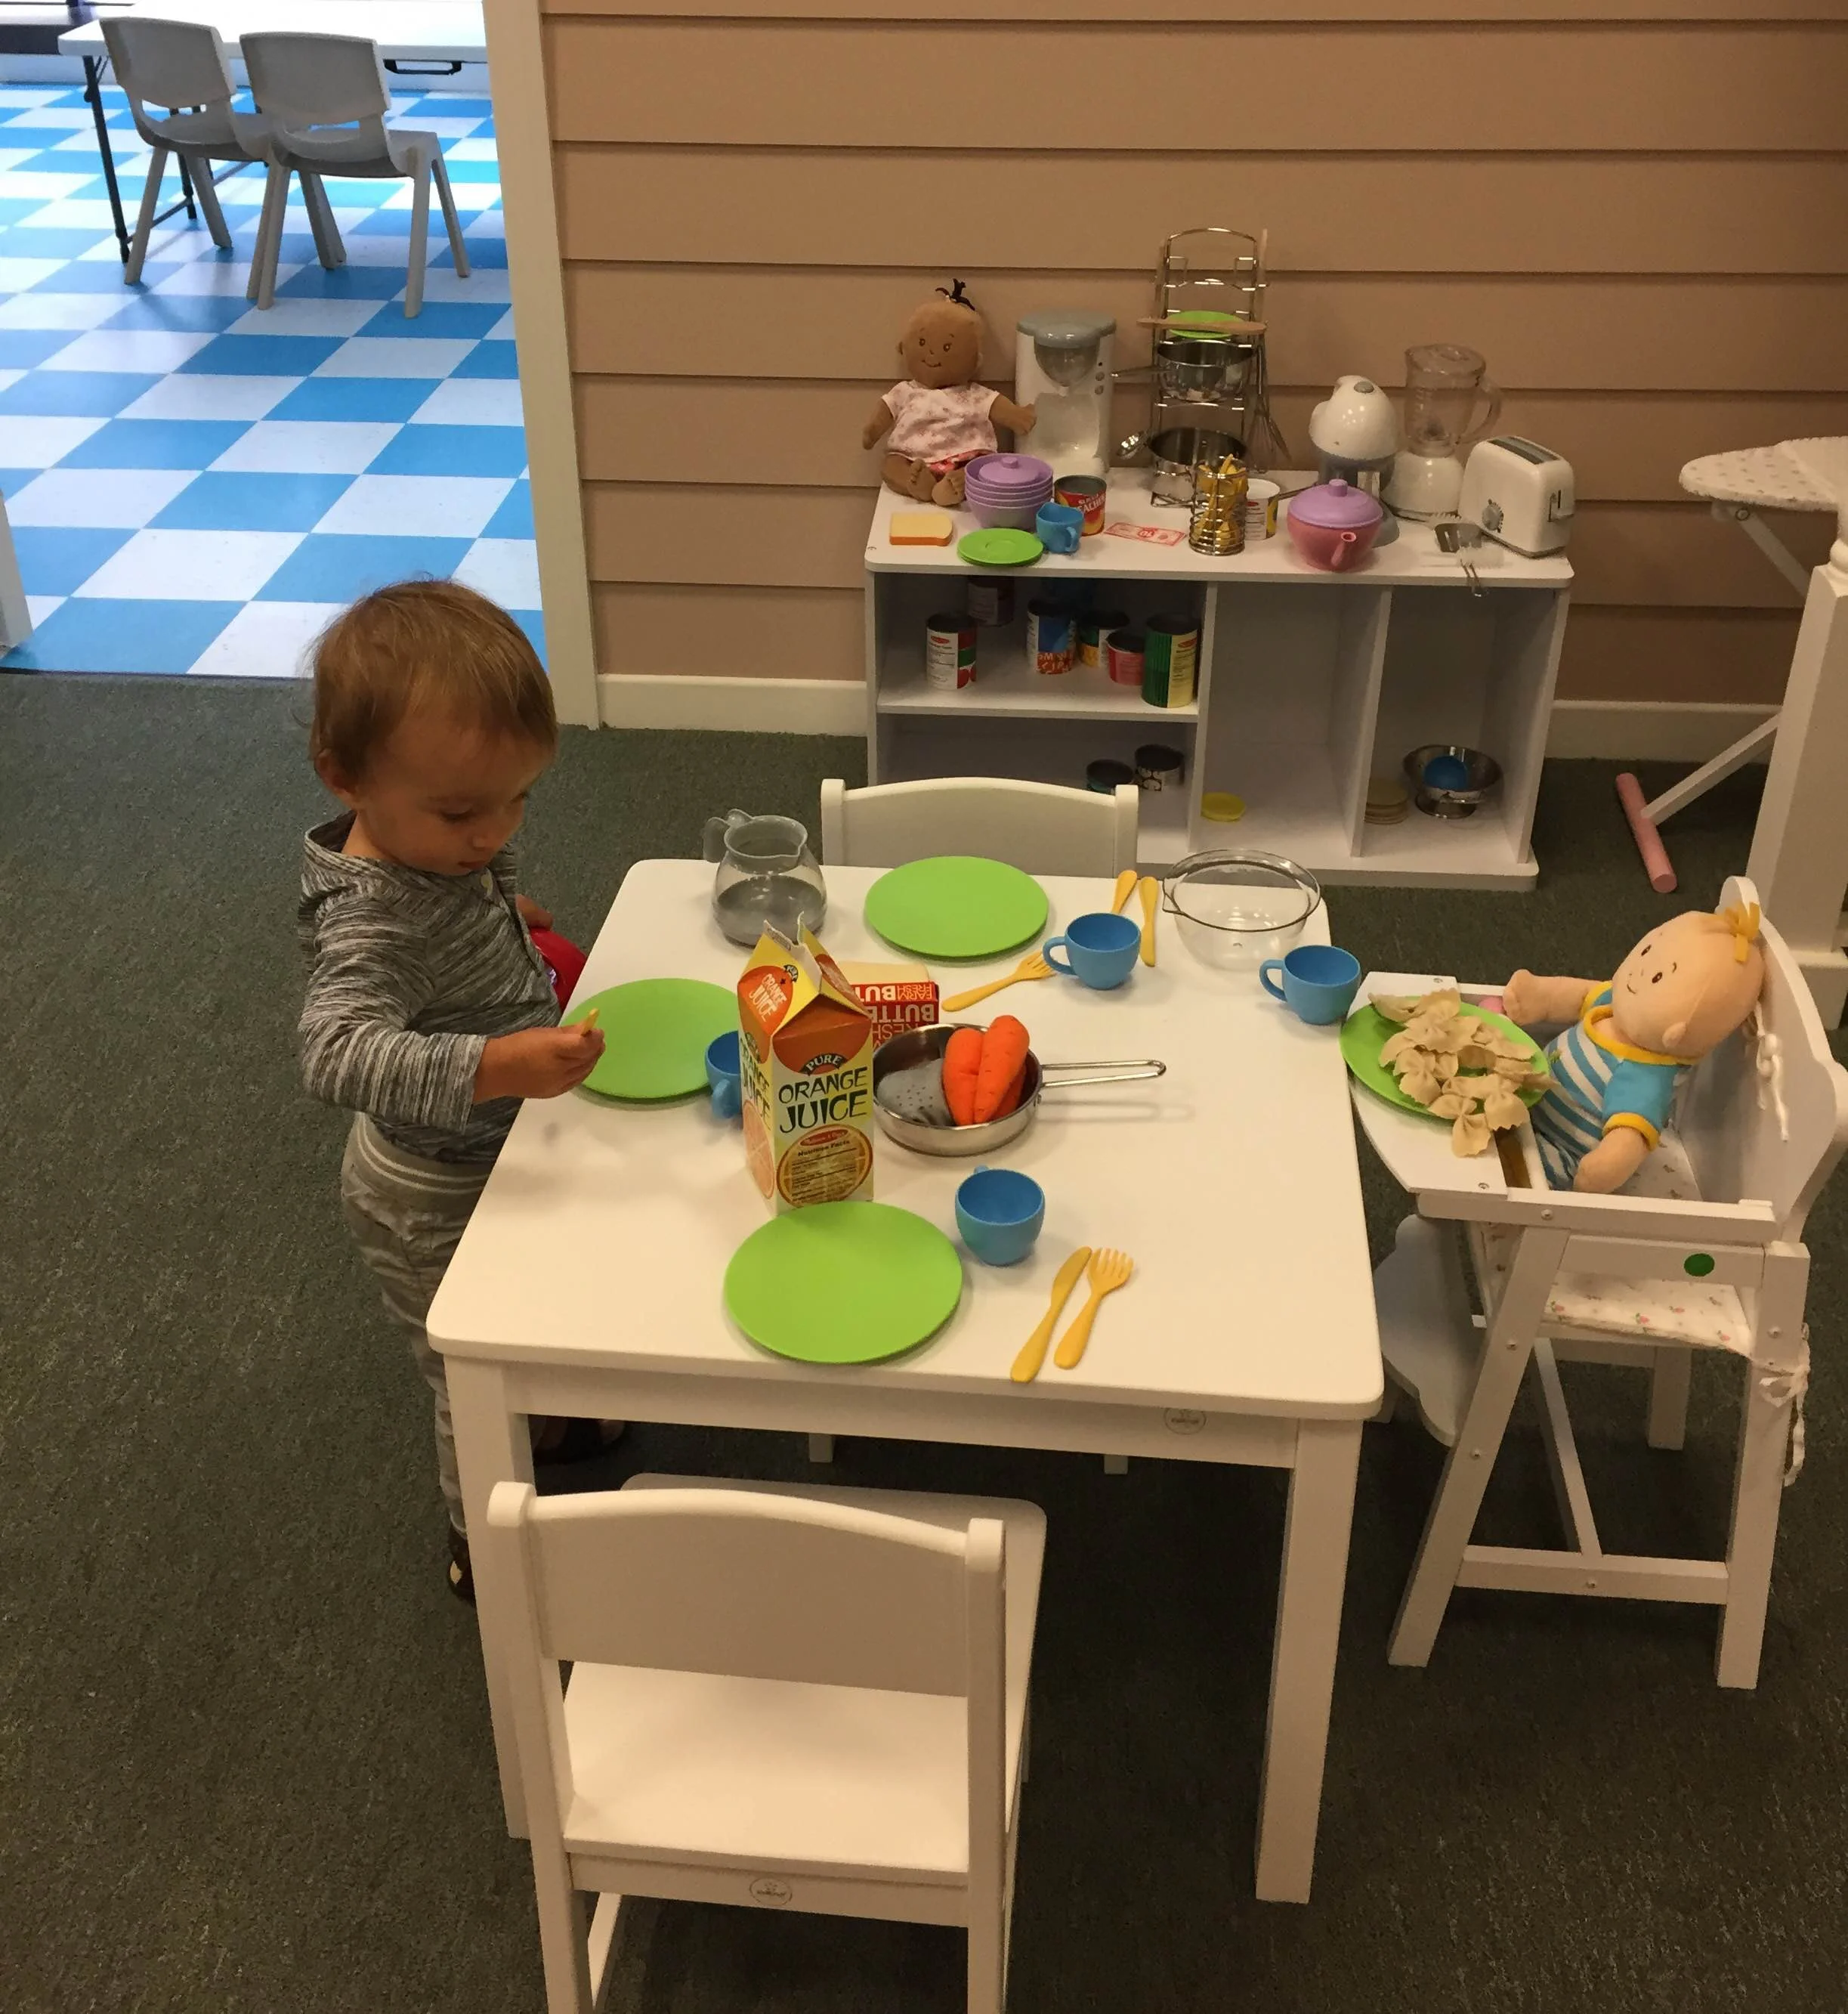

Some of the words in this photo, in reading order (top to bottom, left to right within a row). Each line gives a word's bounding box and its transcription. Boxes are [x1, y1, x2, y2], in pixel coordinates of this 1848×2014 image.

[762, 973, 786, 1005] ORANGE
[854, 985, 896, 1002] BUT
[896, 984, 932, 992] FRESH
[897, 991, 932, 1000] FARM
[749, 985, 777, 1022] JUICE
[864, 1004, 935, 1023] BUTTE
[805, 1054, 843, 1072] PURE
[778, 1066, 867, 1104] ORANGE
[779, 1089, 867, 1134] JUICE
